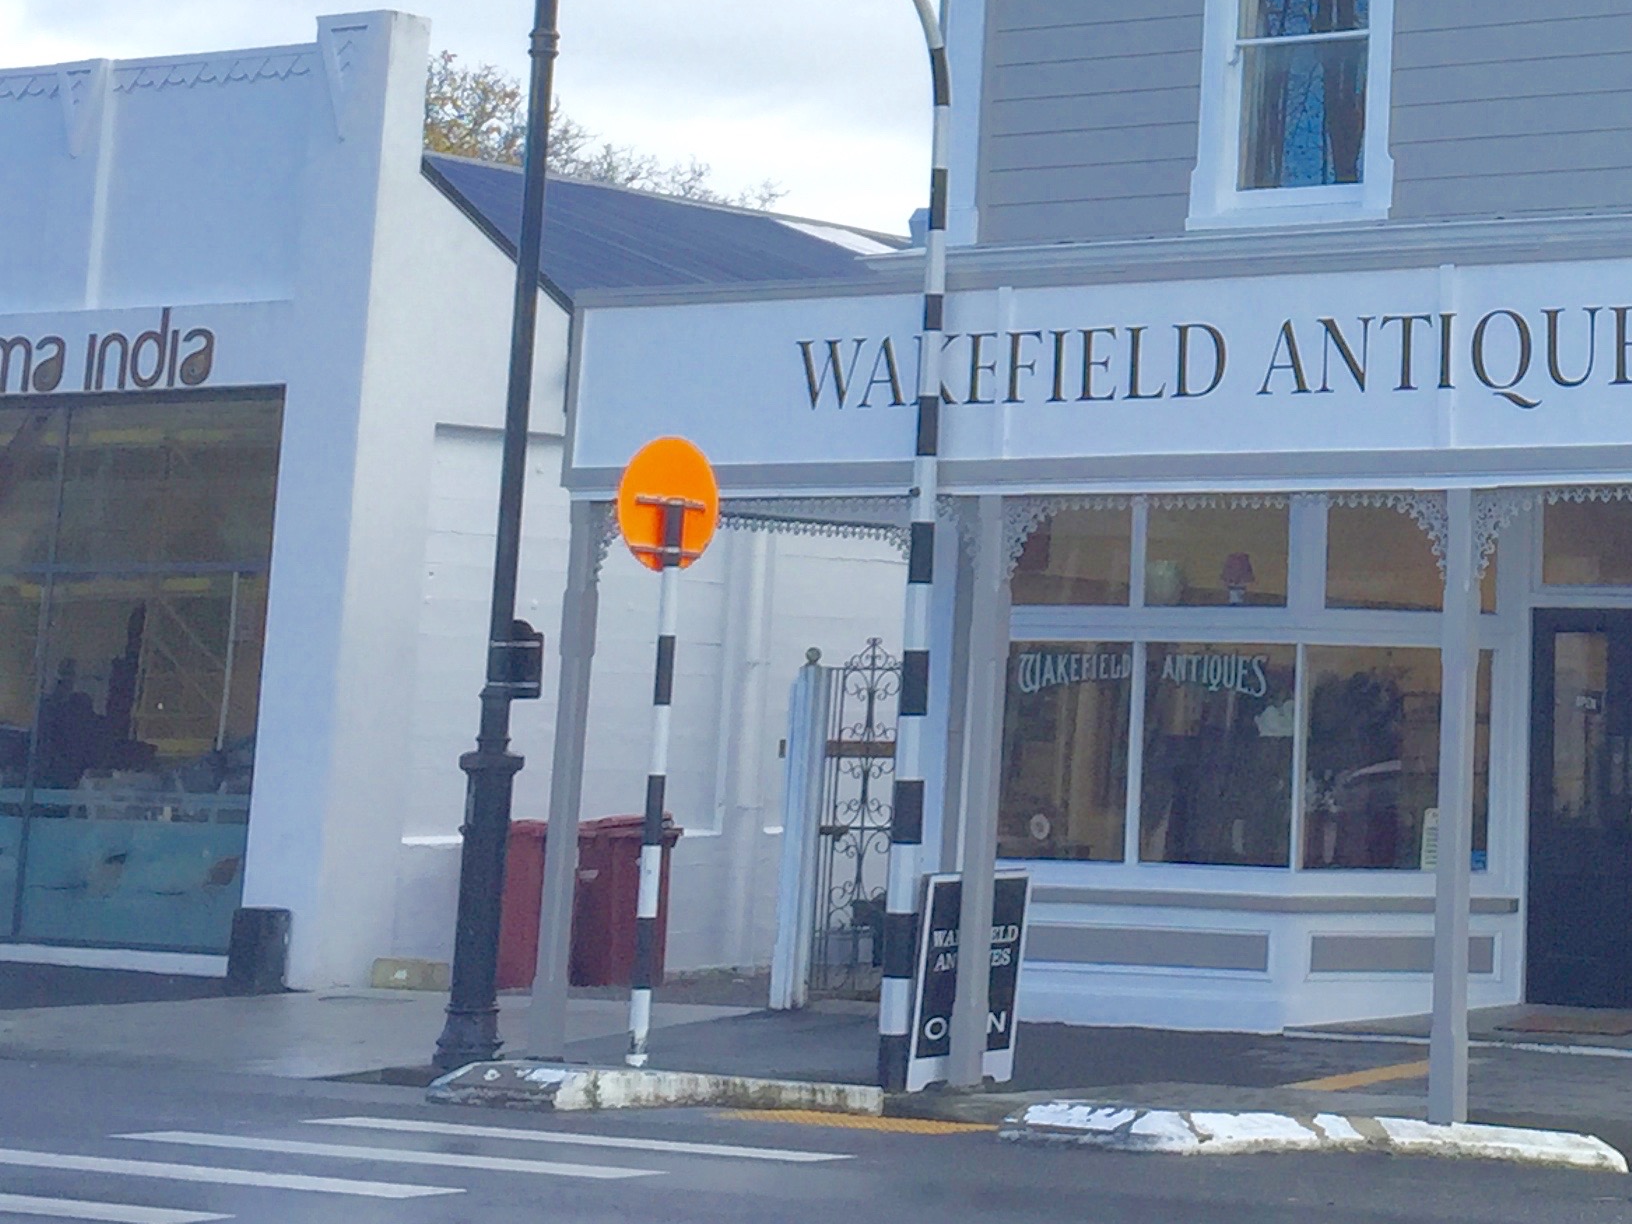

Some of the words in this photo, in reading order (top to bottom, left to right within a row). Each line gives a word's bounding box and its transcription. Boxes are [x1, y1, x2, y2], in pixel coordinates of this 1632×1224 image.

[83, 306, 215, 391] india
[1018, 651, 1131, 694] WAKEFIELD
[1162, 652, 1268, 697] ANTIQUES
[924, 1010, 1007, 1041] ON
